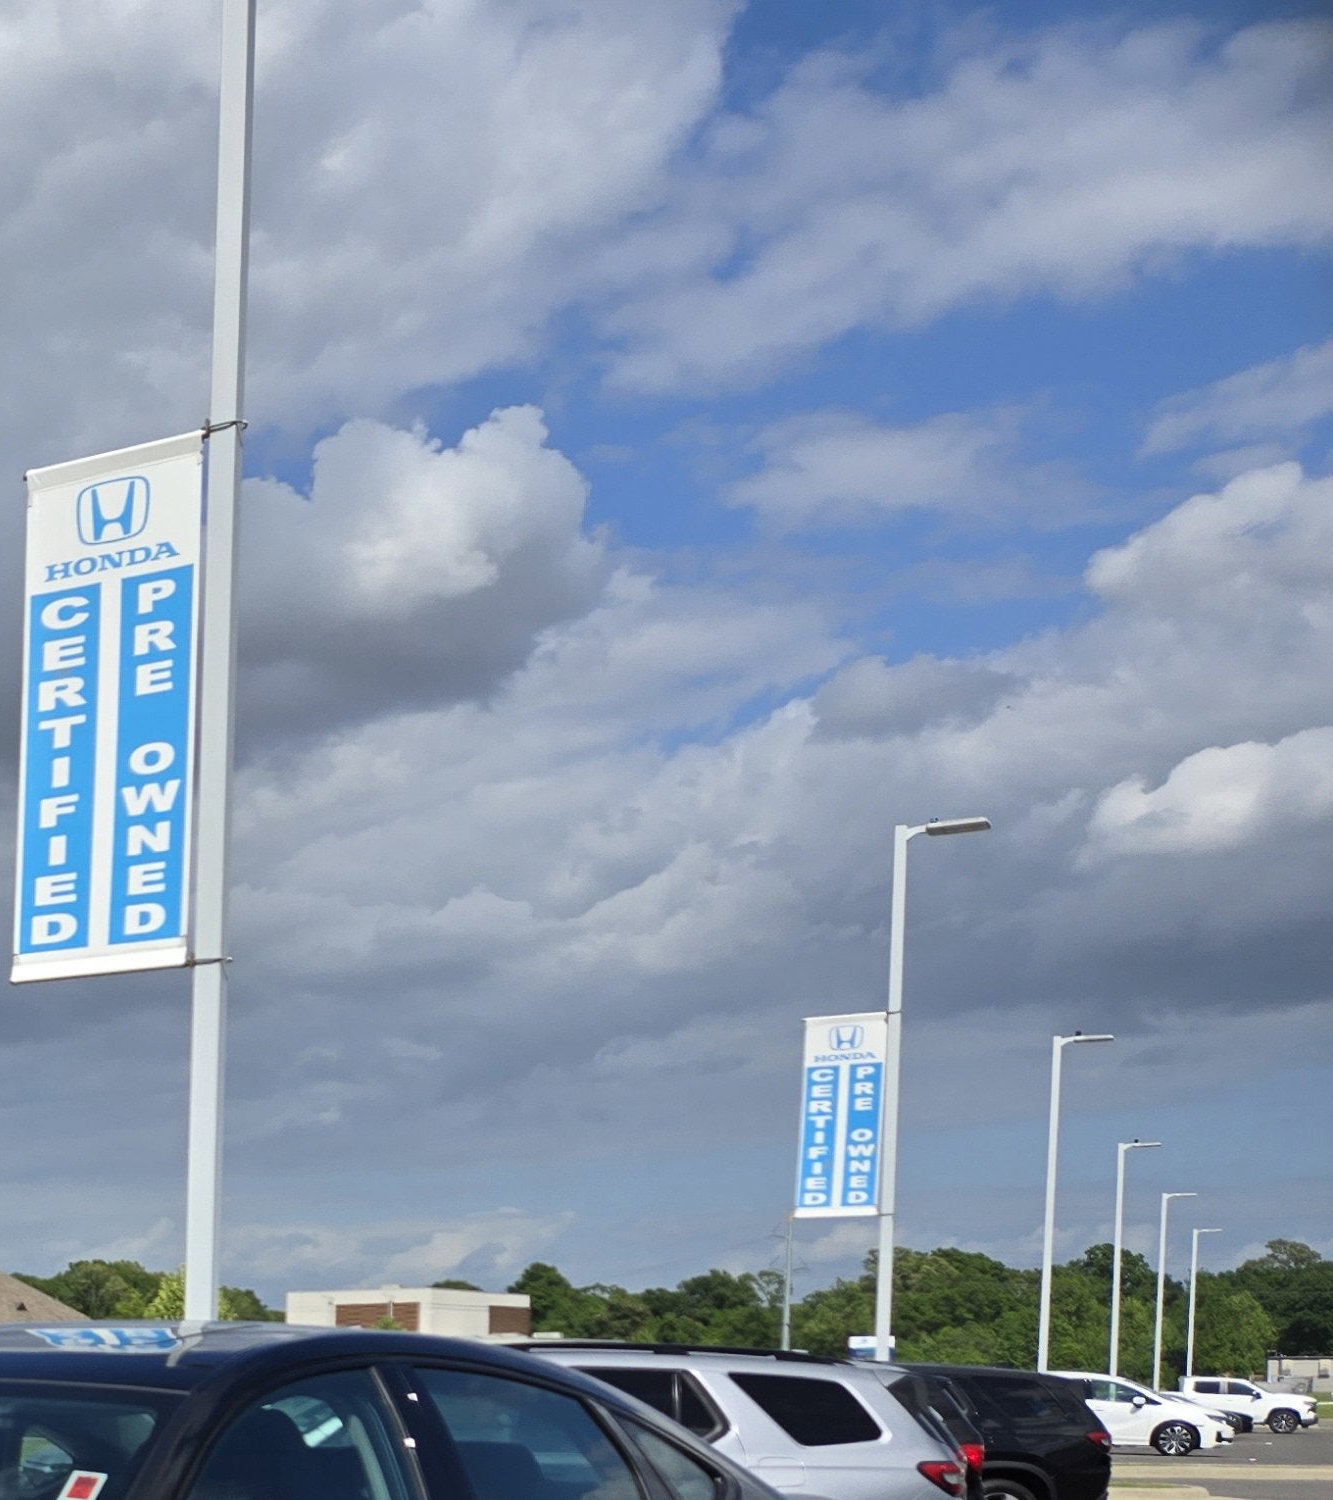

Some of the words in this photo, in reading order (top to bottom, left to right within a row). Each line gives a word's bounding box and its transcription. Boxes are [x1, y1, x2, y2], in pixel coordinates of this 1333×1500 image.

[45, 541, 180, 583] HONDA
[133, 578, 177, 696] PRE
[30, 596, 90, 946] CERTIFIED
[121, 741, 181, 937] OWNED
[813, 1051, 877, 1063] HONDA
[854, 1066, 875, 1111] PRE
[802, 1068, 835, 1206] CERTIFIED
[846, 1127, 876, 1205] OWNED
